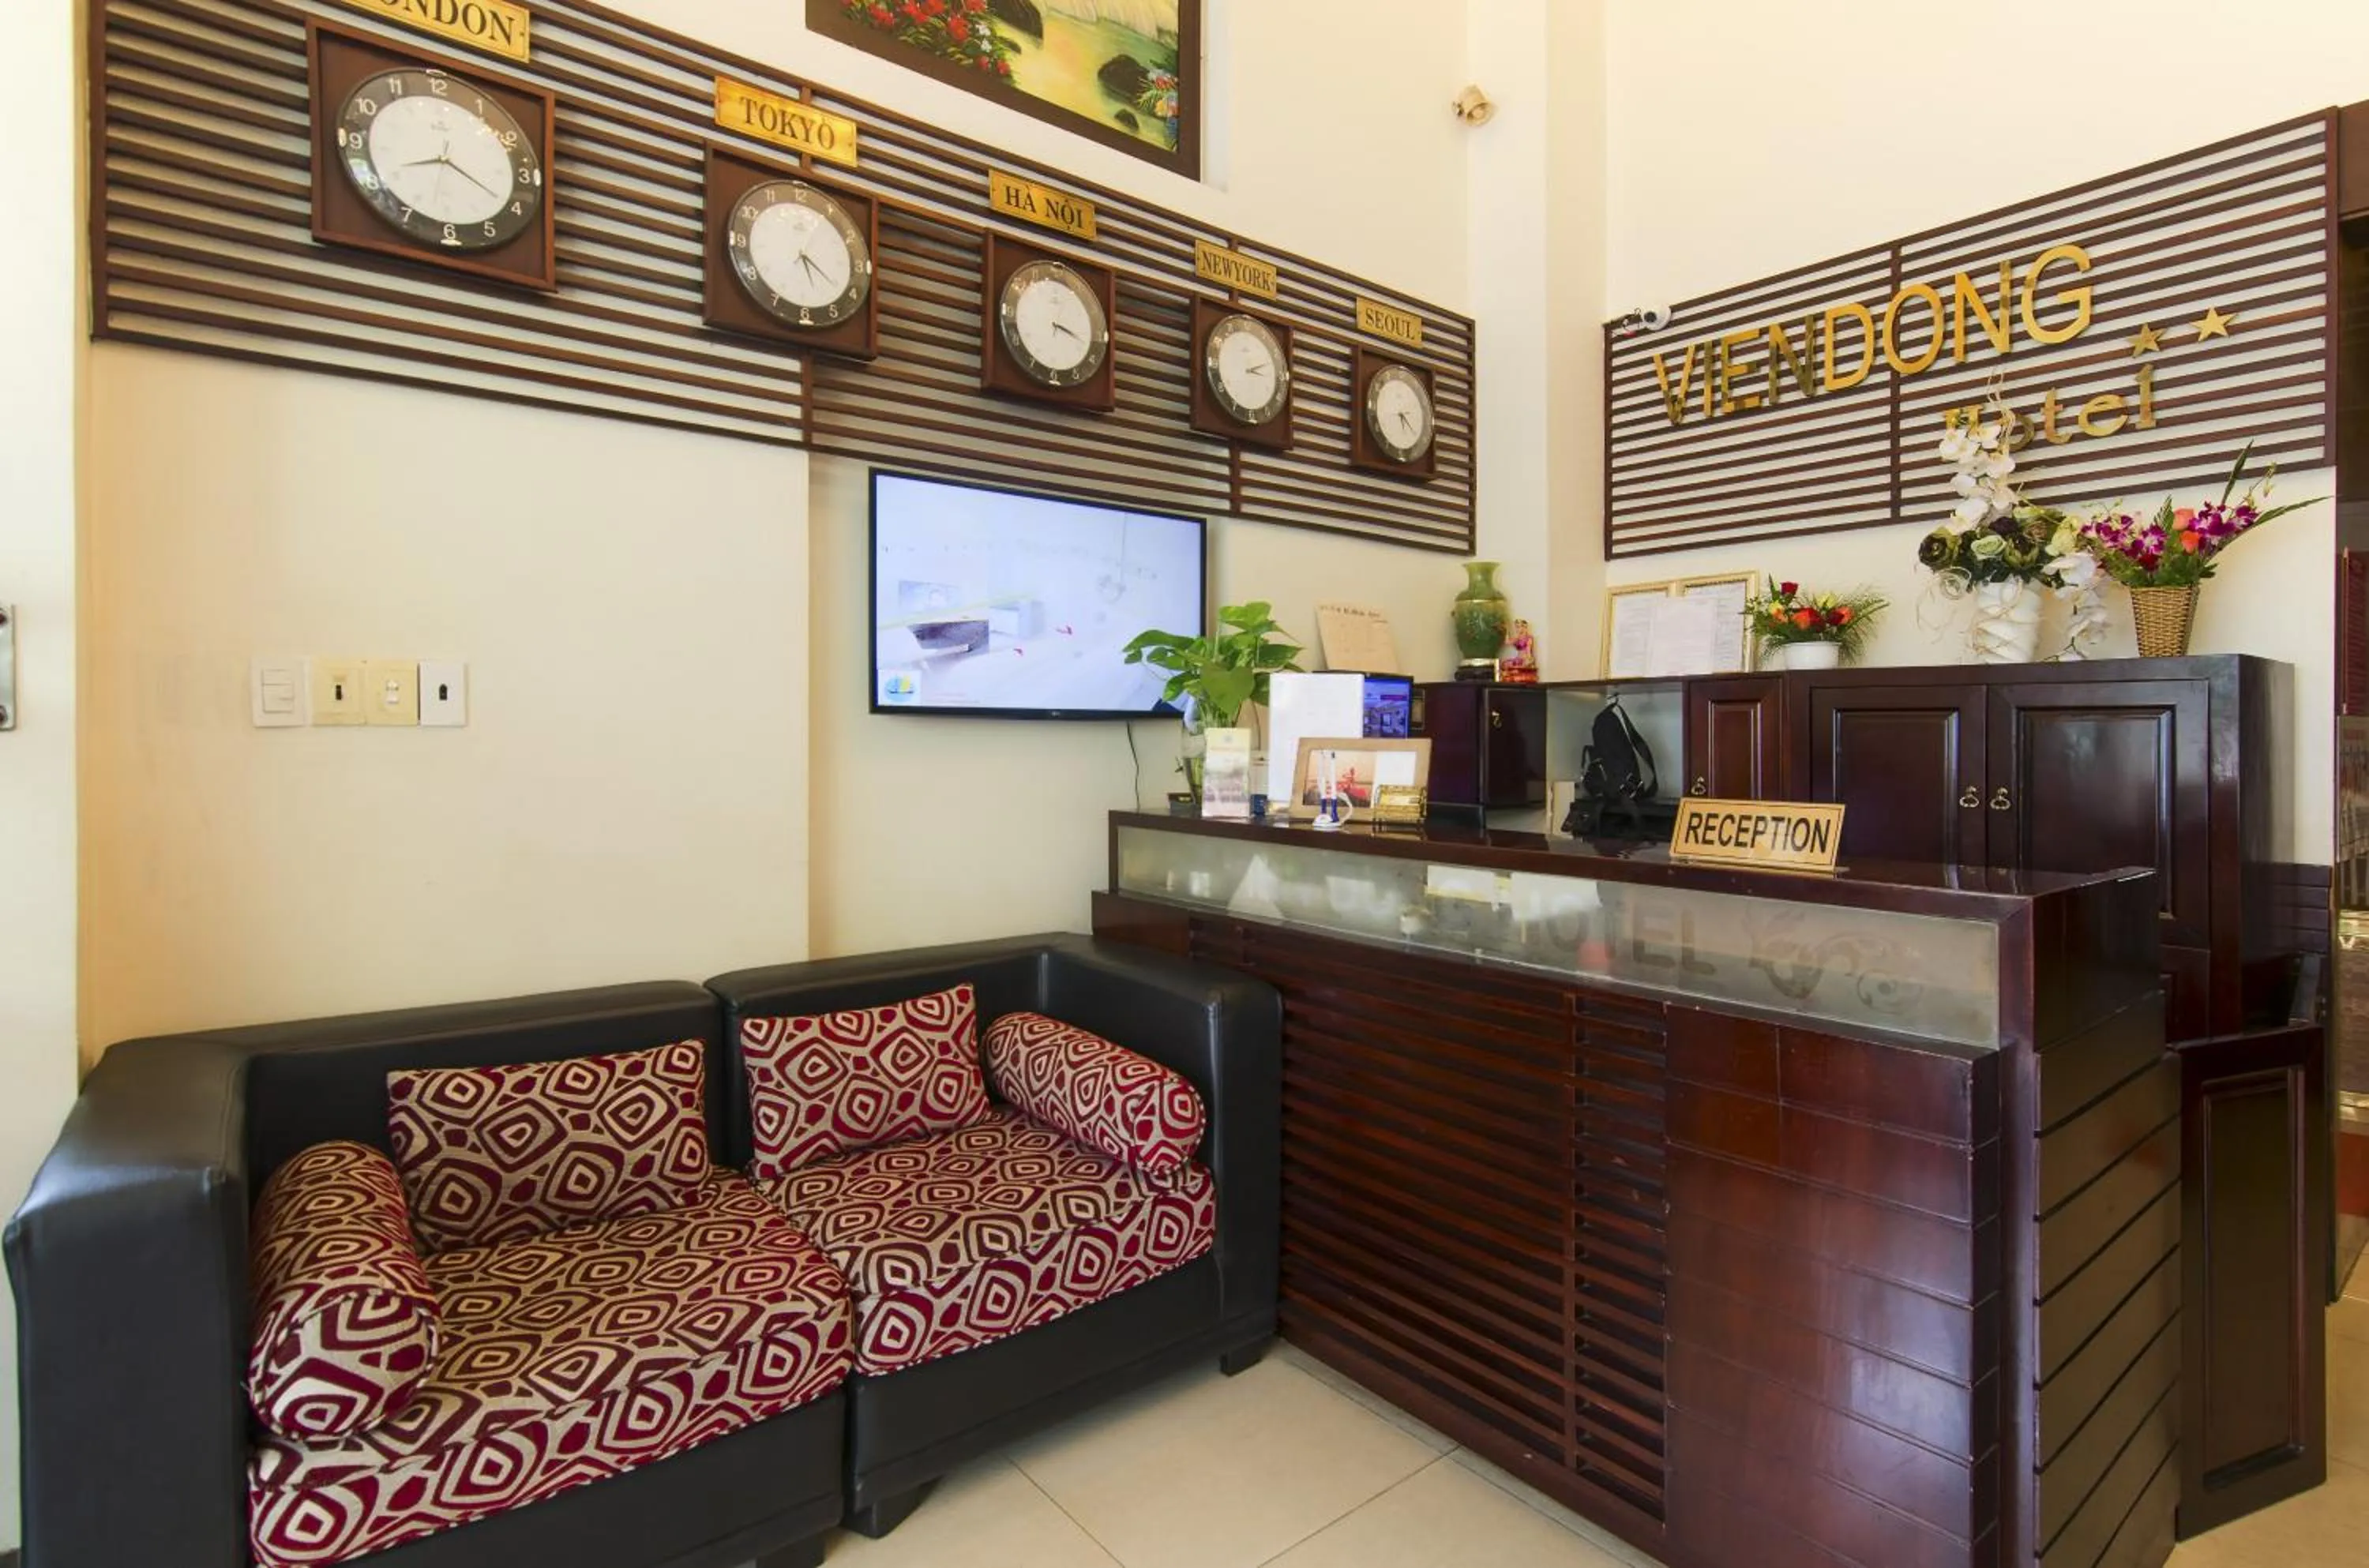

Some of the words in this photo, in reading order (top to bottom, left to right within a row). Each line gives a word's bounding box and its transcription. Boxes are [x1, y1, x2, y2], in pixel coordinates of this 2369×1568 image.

[388, 78, 402, 95] 11
[430, 79, 448, 96] 12
[357, 98, 377, 116] 10
[475, 99, 482, 114] 1
[350, 133, 362, 149] 9
[518, 168, 531, 183] 3
[401, 207, 413, 223] 7
[511, 201, 523, 215] 4
[443, 223, 456, 239] 6
[484, 222, 496, 237] 5
[1365, 308, 1415, 340] SEOUL
[1684, 812, 1831, 853] RECEPTION
